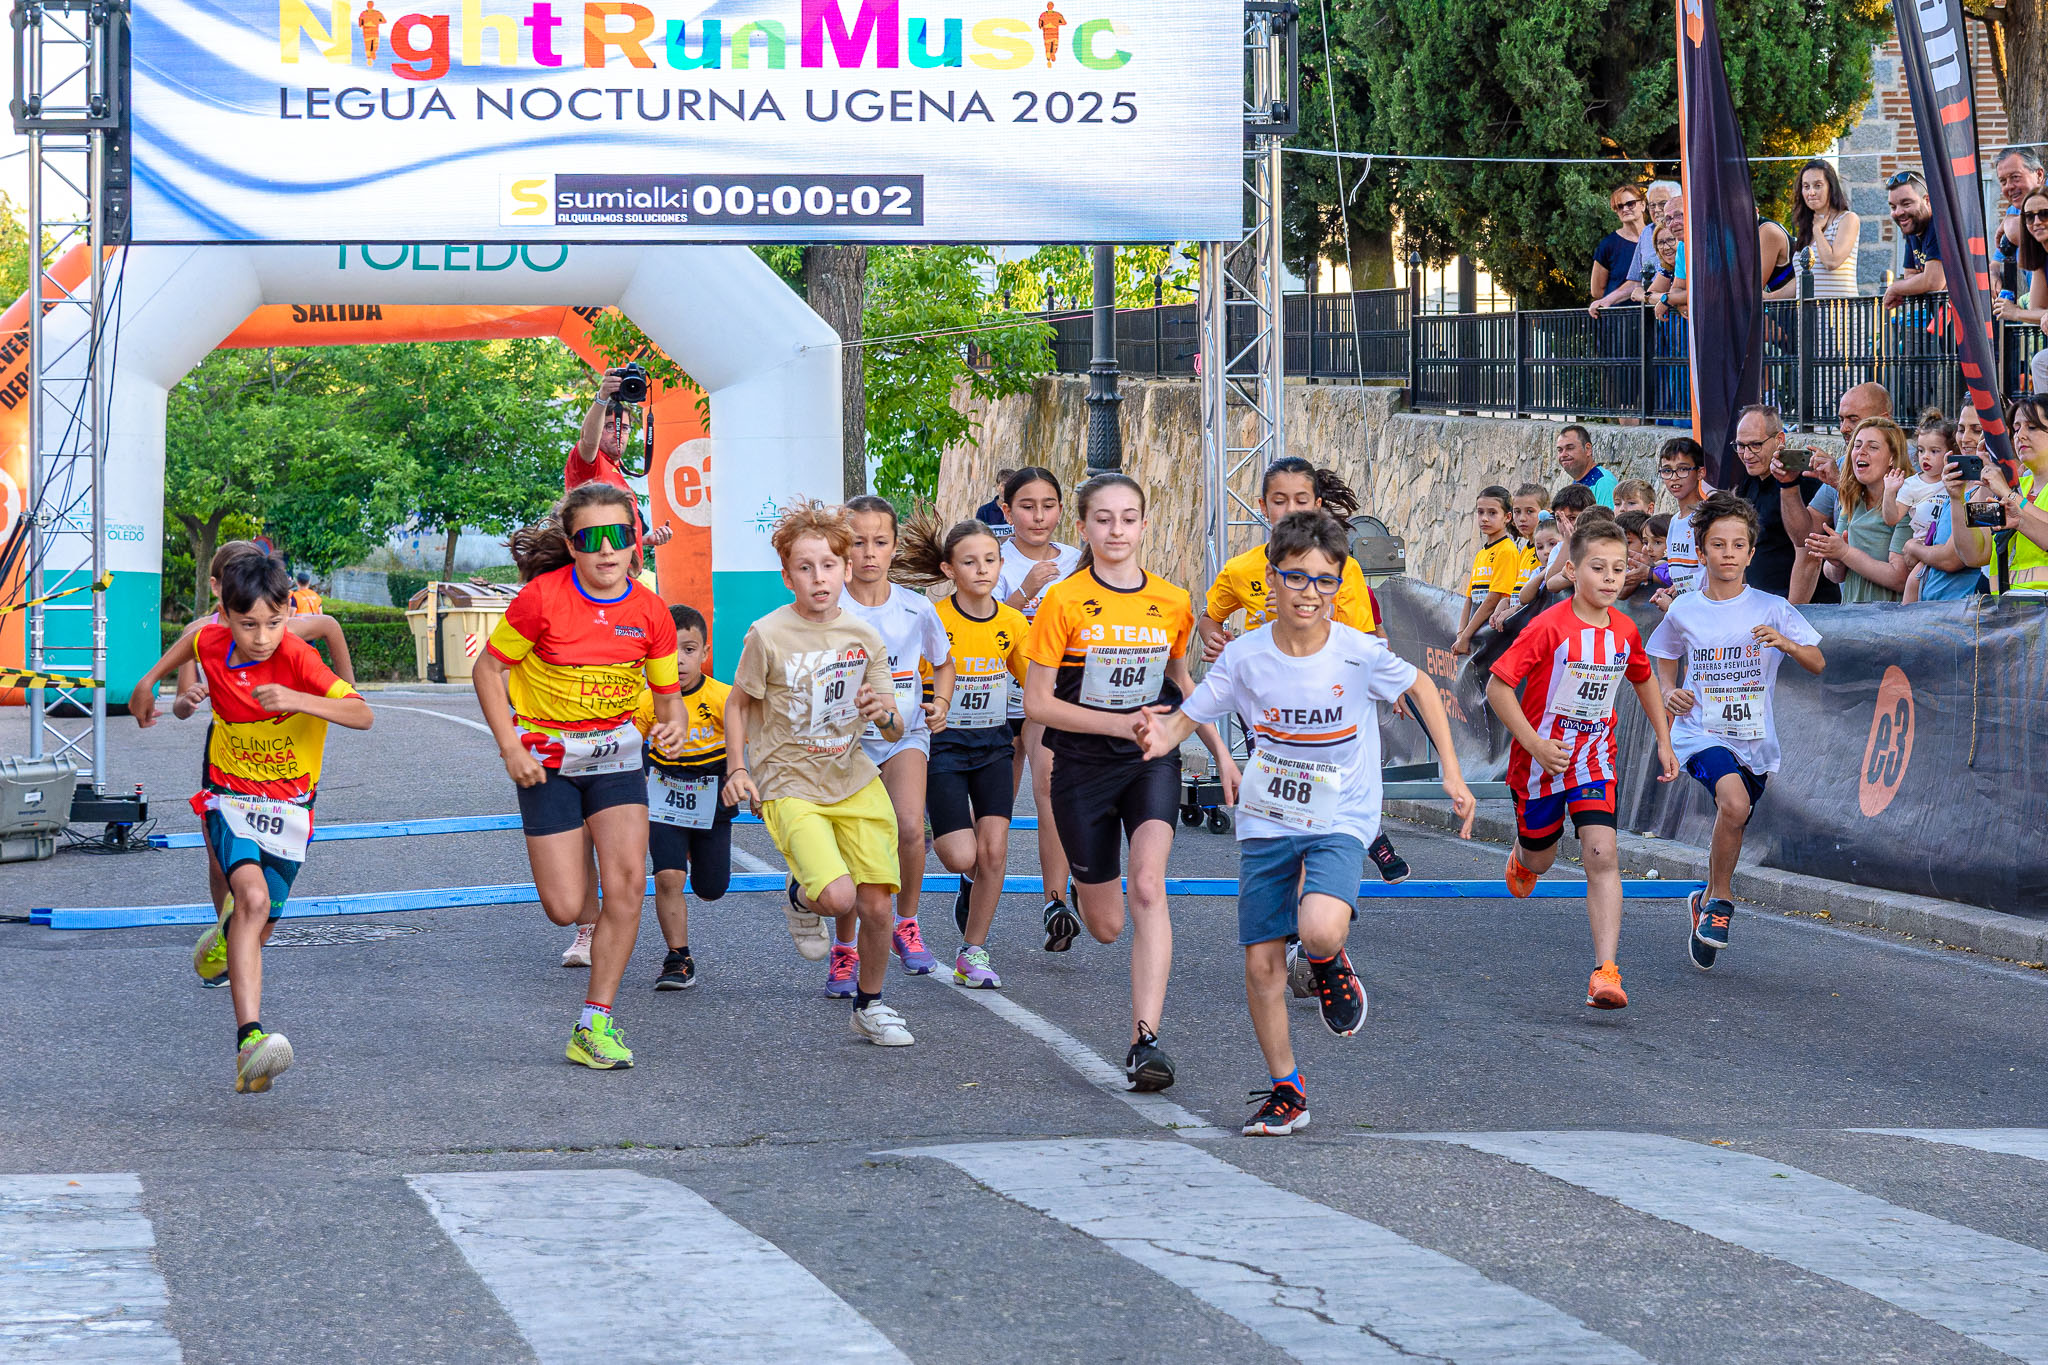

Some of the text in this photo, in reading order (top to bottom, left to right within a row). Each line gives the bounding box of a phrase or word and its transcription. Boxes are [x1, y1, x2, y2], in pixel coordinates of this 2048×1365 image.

[280, 87, 1137, 124] LEGUA NOCTURNA UGENA 2025
[558, 187, 688, 209] sumialki
[692, 184, 912, 216] 00:00:02
[558, 213, 688, 223] ALQUILAMOS SOLUCIONES
[292, 304, 382, 323] SALIDA
[105, 530, 145, 541] OLEDO
[1672, 543, 1689, 553] EAM
[1081, 624, 1168, 645] e3 TEAM
[1118, 647, 1150, 655] NOCTURNA
[1150, 646, 1168, 654] UGENA
[1693, 647, 1741, 661] CIRCUITO
[1589, 664, 1613, 672] NOCTURNA
[1692, 668, 1761, 682] divinaseguros
[1693, 662, 1721, 670] CARRERAS
[993, 672, 1006, 680] UGENA
[1109, 666, 1147, 687] 464
[580, 681, 634, 697] LACASA
[825, 680, 845, 705] 460
[1577, 682, 1609, 701] 455
[960, 692, 990, 710] 457
[1722, 703, 1751, 721] 454
[1560, 719, 1593, 732] RIYADH
[231, 735, 294, 752] CLÍNICA
[1867, 697, 1909, 788] e3
[231, 748, 296, 764] LACASA
[1262, 750, 1337, 773] LEGUA NOCTURNA UGENA
[1267, 776, 1312, 804] 468
[665, 789, 697, 810] 458
